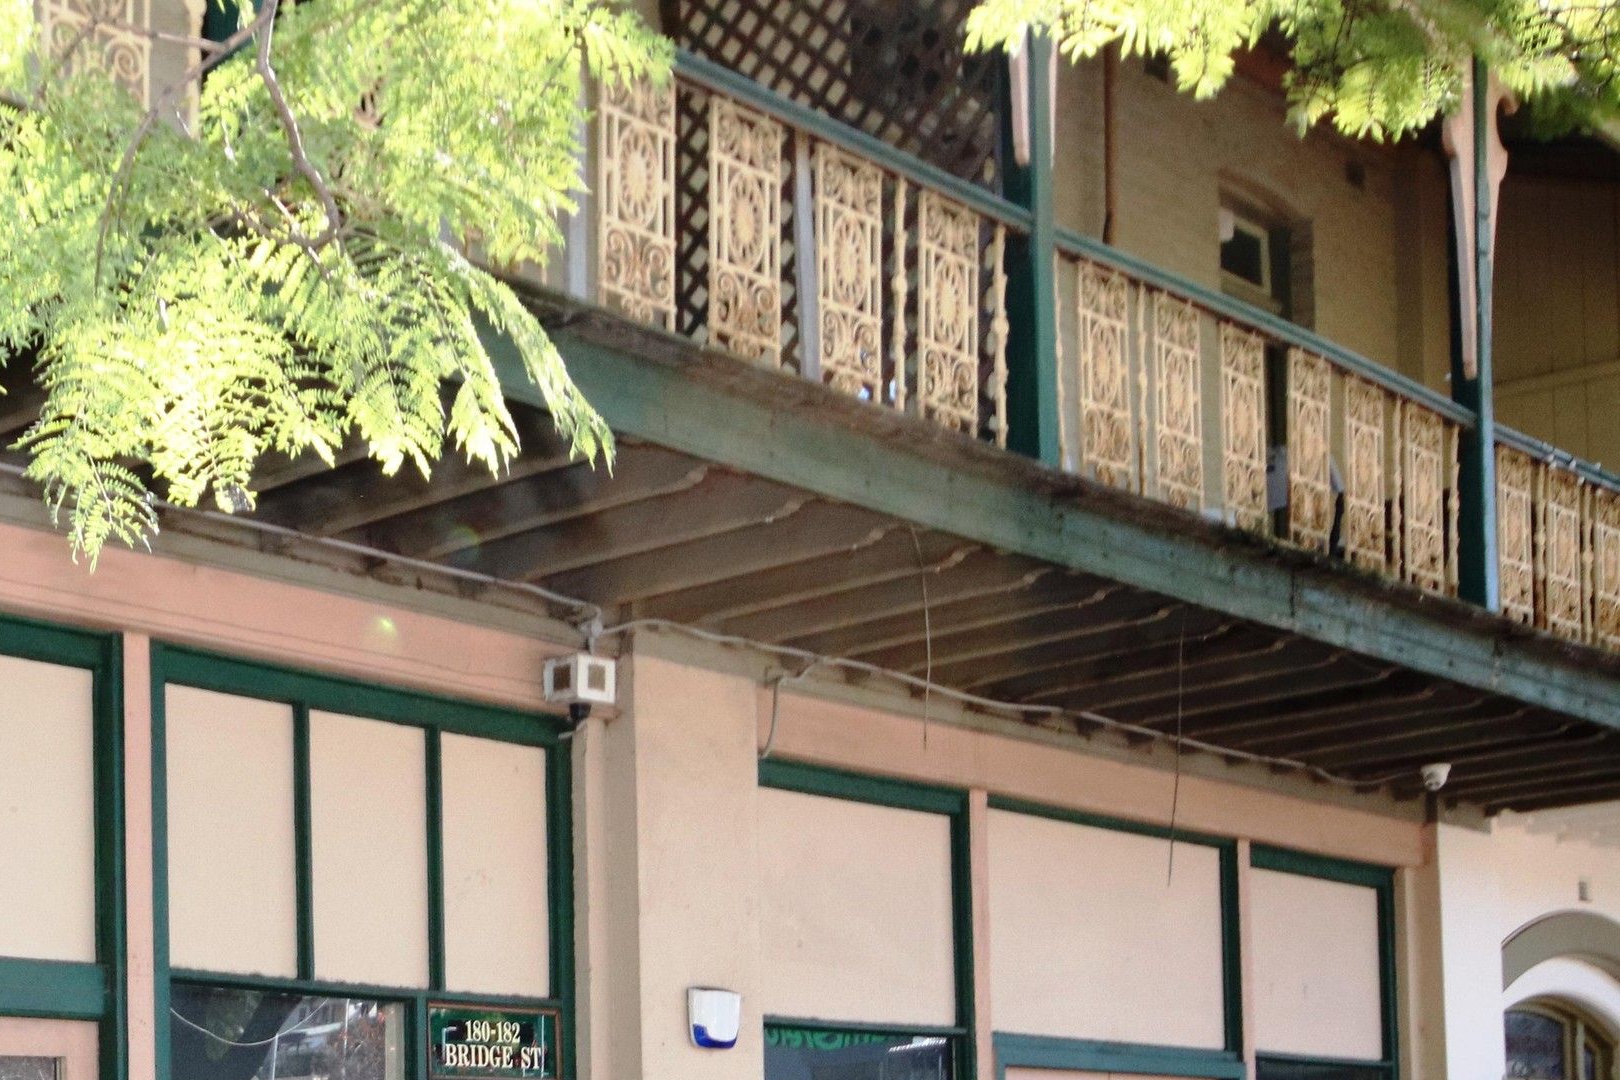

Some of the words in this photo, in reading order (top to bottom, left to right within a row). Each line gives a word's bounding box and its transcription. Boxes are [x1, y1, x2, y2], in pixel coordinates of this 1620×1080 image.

[464, 1020, 521, 1043] 180-182
[445, 1043, 514, 1069] BRIDGE
[520, 1047, 542, 1069] ST
